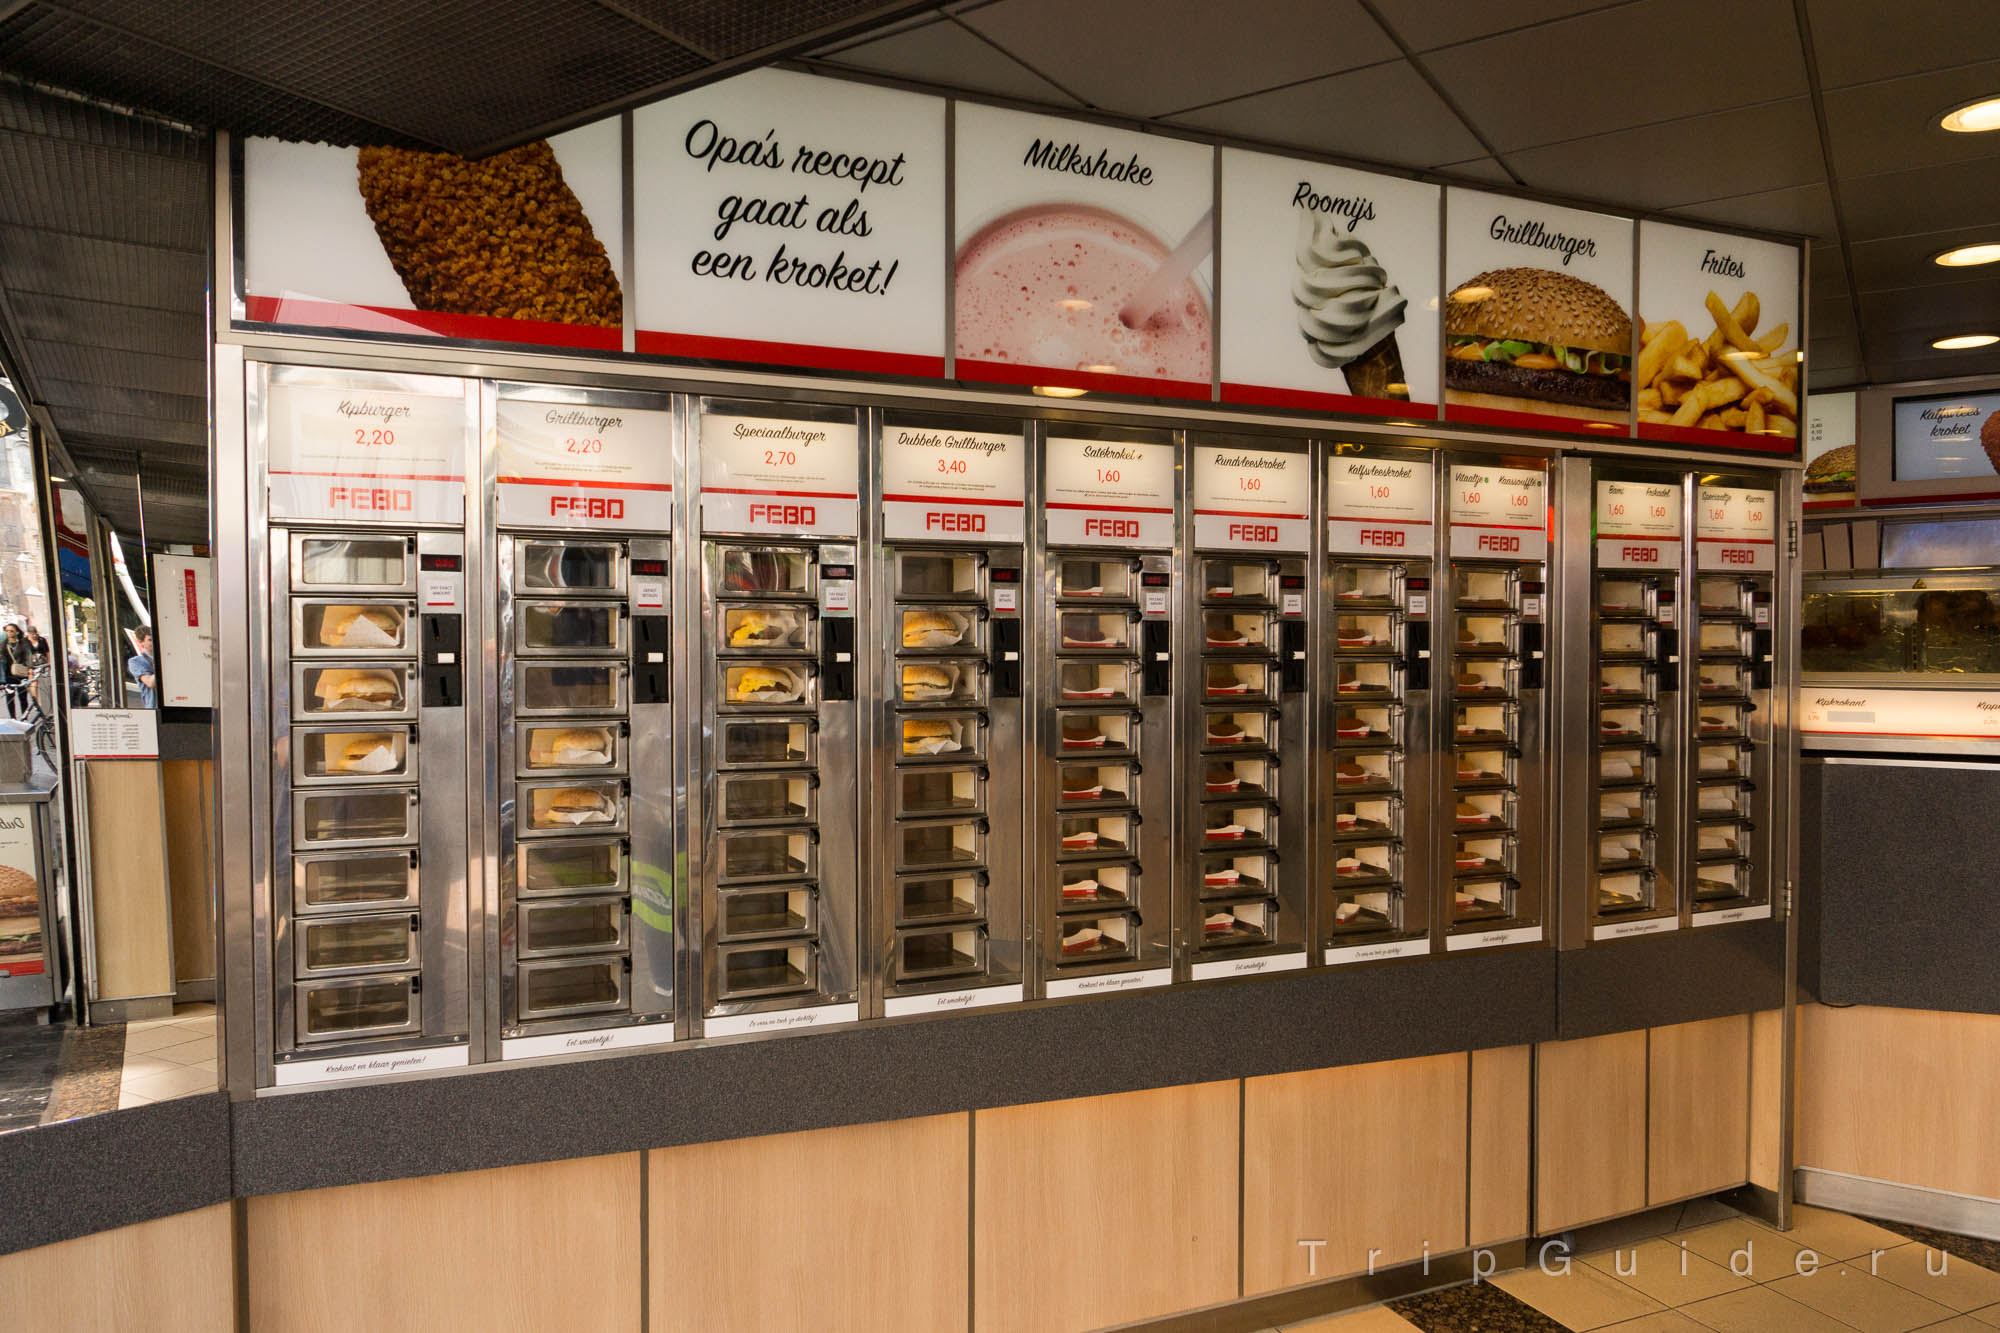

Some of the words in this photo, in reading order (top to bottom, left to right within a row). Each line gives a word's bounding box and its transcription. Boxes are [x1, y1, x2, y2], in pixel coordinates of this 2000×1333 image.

[685, 119, 784, 172] Opa's
[791, 145, 905, 193] recept
[1023, 137, 1154, 187] Milkshake
[1292, 181, 1376, 229] Roomijs
[714, 194, 809, 241] gaat
[816, 198, 873, 237] als
[1489, 214, 1598, 259] Grillburger
[692, 247, 756, 280] een
[764, 243, 898, 295] kroket!
[1701, 248, 1746, 280] Frites
[337, 400, 411, 425] Kipburger
[545, 408, 623, 434] Grillburger
[355, 429, 395, 447] 2,20
[733, 423, 826, 448] Speciaalburger
[1930, 423, 1971, 437] kroket
[566, 438, 602, 455] 2,20
[898, 432, 942, 449] Dubbele
[944, 435, 1007, 456] Grillburger
[765, 450, 796, 467] 2,70
[1083, 445, 1136, 461] Satékroket
[937, 459, 967, 475] 3,40
[1214, 454, 1286, 470] Rundvleeskroket
[1097, 469, 1120, 484] 1,60
[1348, 464, 1412, 480] Kalfsvleeskroket
[1239, 477, 1261, 491] 1,60
[1369, 486, 1390, 499] 1,60
[329, 487, 412, 511] FEBO
[1462, 491, 1481, 504] 1,60
[1510, 495, 1528, 507] 1,60
[550, 496, 624, 519] FEBO
[750, 504, 816, 525] FEBO
[1608, 504, 1624, 516] 1,60
[1650, 506, 1666, 518] 1,60
[1709, 509, 1725, 521] 1,60
[1747, 510, 1763, 522] 1,60
[926, 512, 986, 533] FEBO
[1085, 519, 1140, 538] FEBO
[1229, 524, 1278, 543] FEBO
[1360, 530, 1405, 547] FEBO
[1479, 535, 1520, 552] FEBO
[1622, 547, 1658, 562] FEBO
[1721, 549, 1754, 564] FEBO
[1816, 698, 1867, 707] Kipkrokant
[566, 1039, 577, 1047] Eet
[579, 1034, 615, 1046] smakelijk!
[325, 1063, 356, 1073] Krokant
[368, 1060, 389, 1069] klaar
[391, 1056, 427, 1070] genieten!
